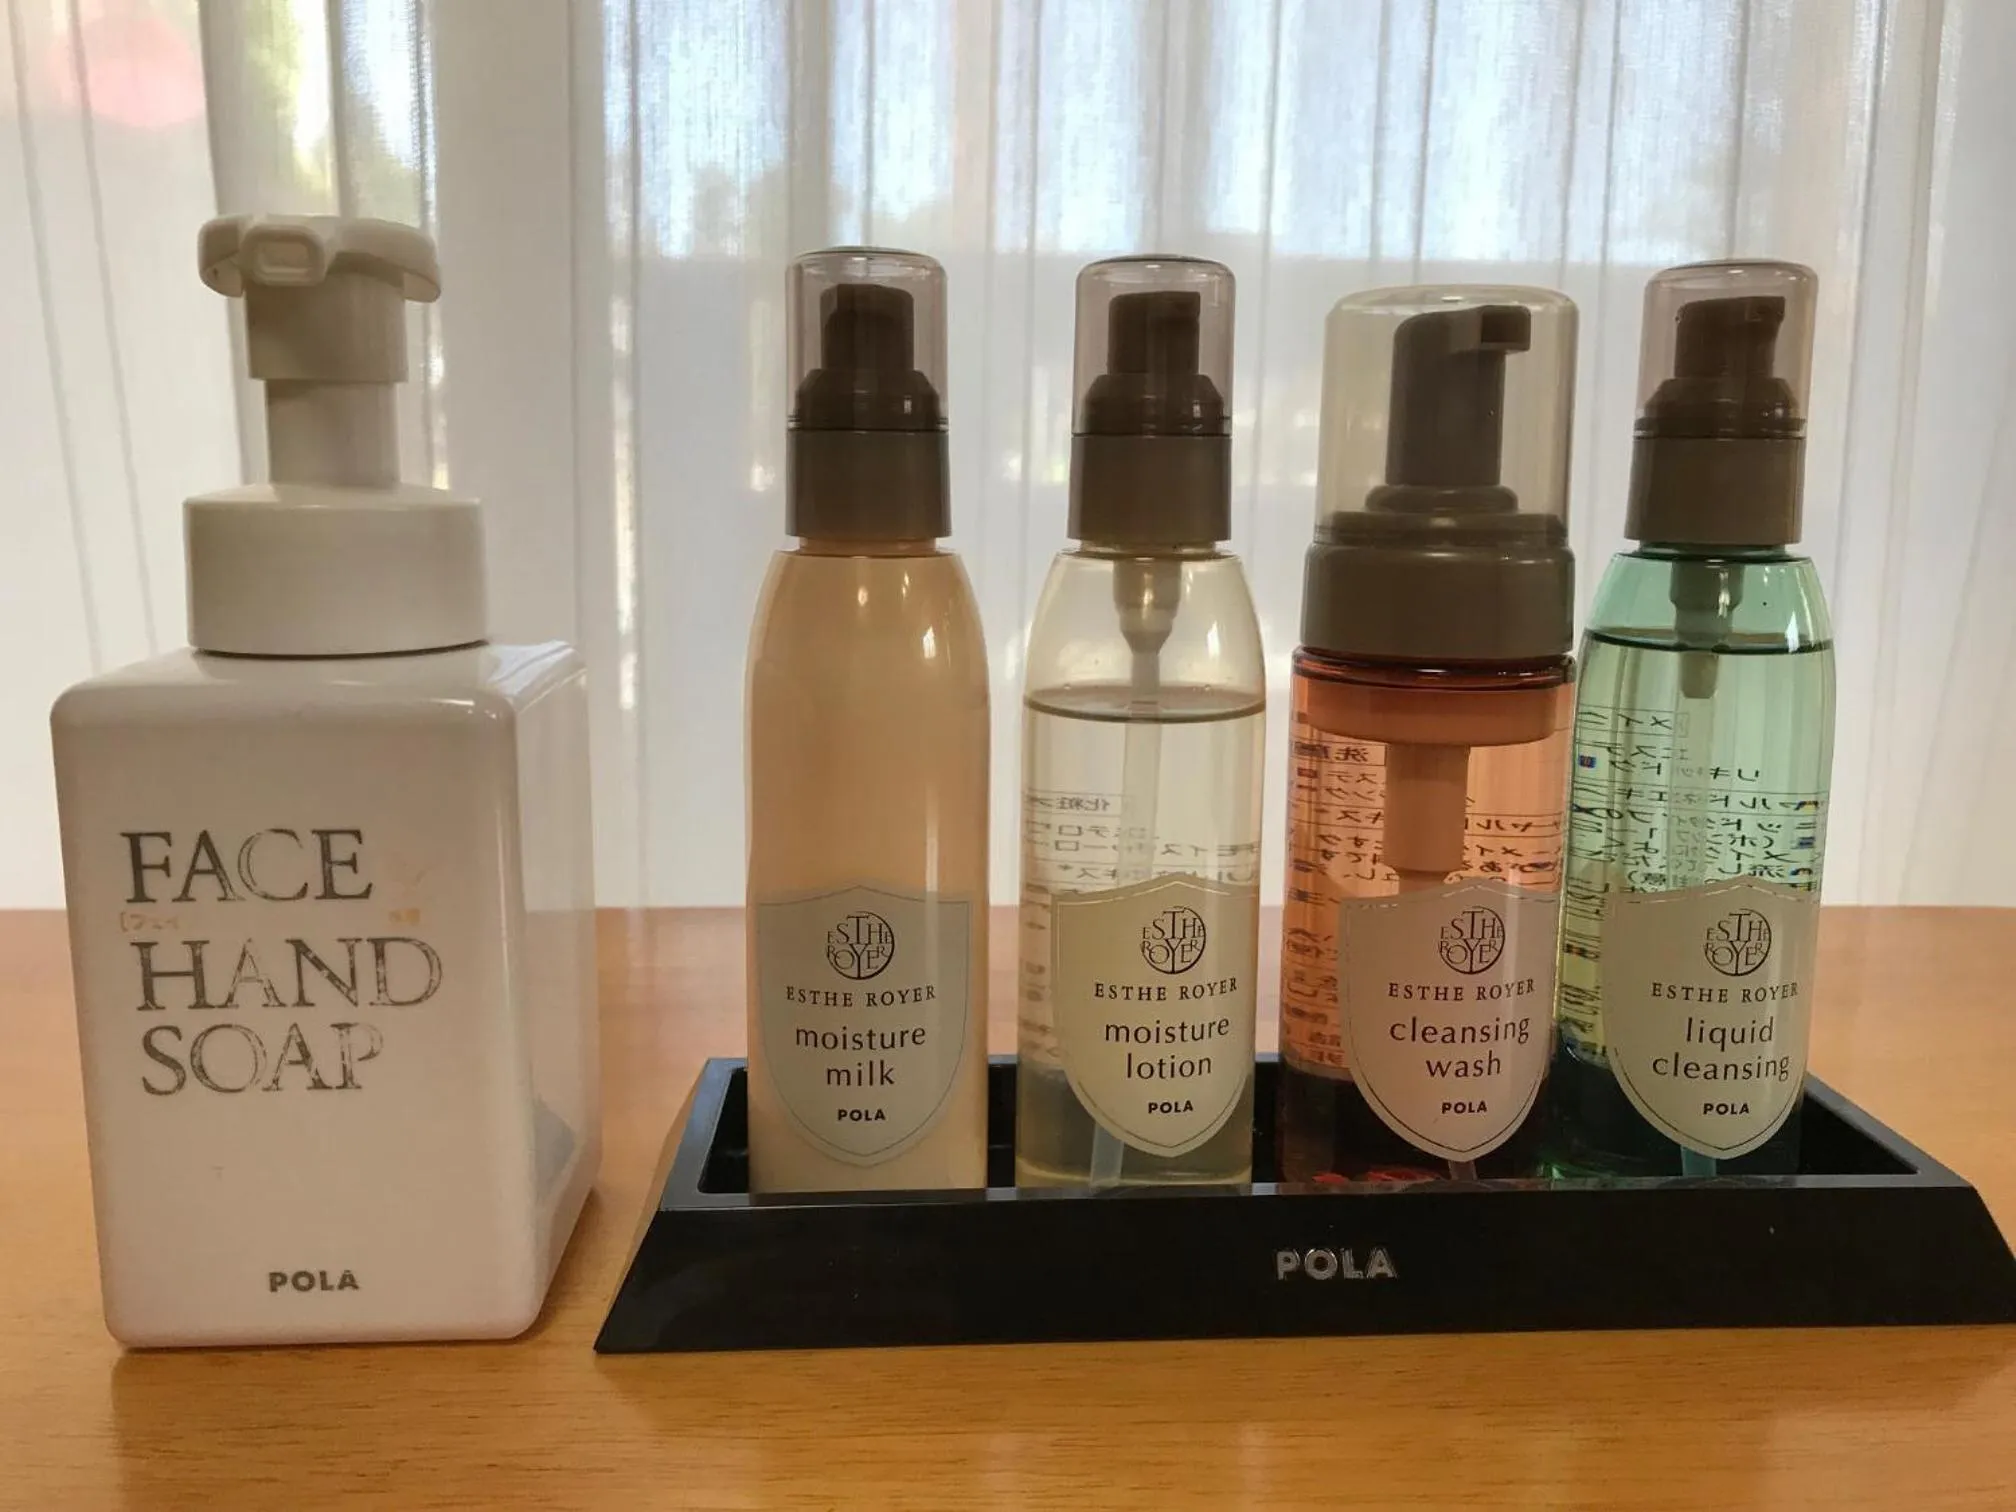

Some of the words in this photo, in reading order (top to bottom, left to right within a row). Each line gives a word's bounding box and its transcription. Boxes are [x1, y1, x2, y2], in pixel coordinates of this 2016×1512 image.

[120, 829, 372, 903] FACE
[130, 937, 442, 1011] HAND
[787, 986, 852, 1007] ESTHE
[866, 986, 937, 1007] ROYER
[1095, 983, 1166, 1001] ESTHE
[1179, 976, 1238, 1000] ROYER
[1389, 983, 1463, 1001] ESTHE
[1476, 979, 1536, 1000] ROYER
[1652, 983, 1727, 1003] ESTHE
[1742, 983, 1799, 1003] ROYER
[797, 1026, 925, 1050] moisture
[1106, 1019, 1229, 1043] moisture
[1390, 1017, 1529, 1044] cleansing
[1687, 1017, 1773, 1051] liquid
[142, 1023, 382, 1096] SOAP
[1128, 1053, 1211, 1079] lotion
[1426, 1050, 1500, 1077] wash
[1653, 1052, 1789, 1081] cleansing
[827, 1060, 894, 1086] milk
[838, 1109, 885, 1121] POLA
[1148, 1100, 1193, 1113] POLA
[1442, 1101, 1487, 1114] POLA
[1704, 1103, 1749, 1115] POLA
[1276, 1248, 1397, 1281] POLA
[269, 1270, 359, 1292] POLA
